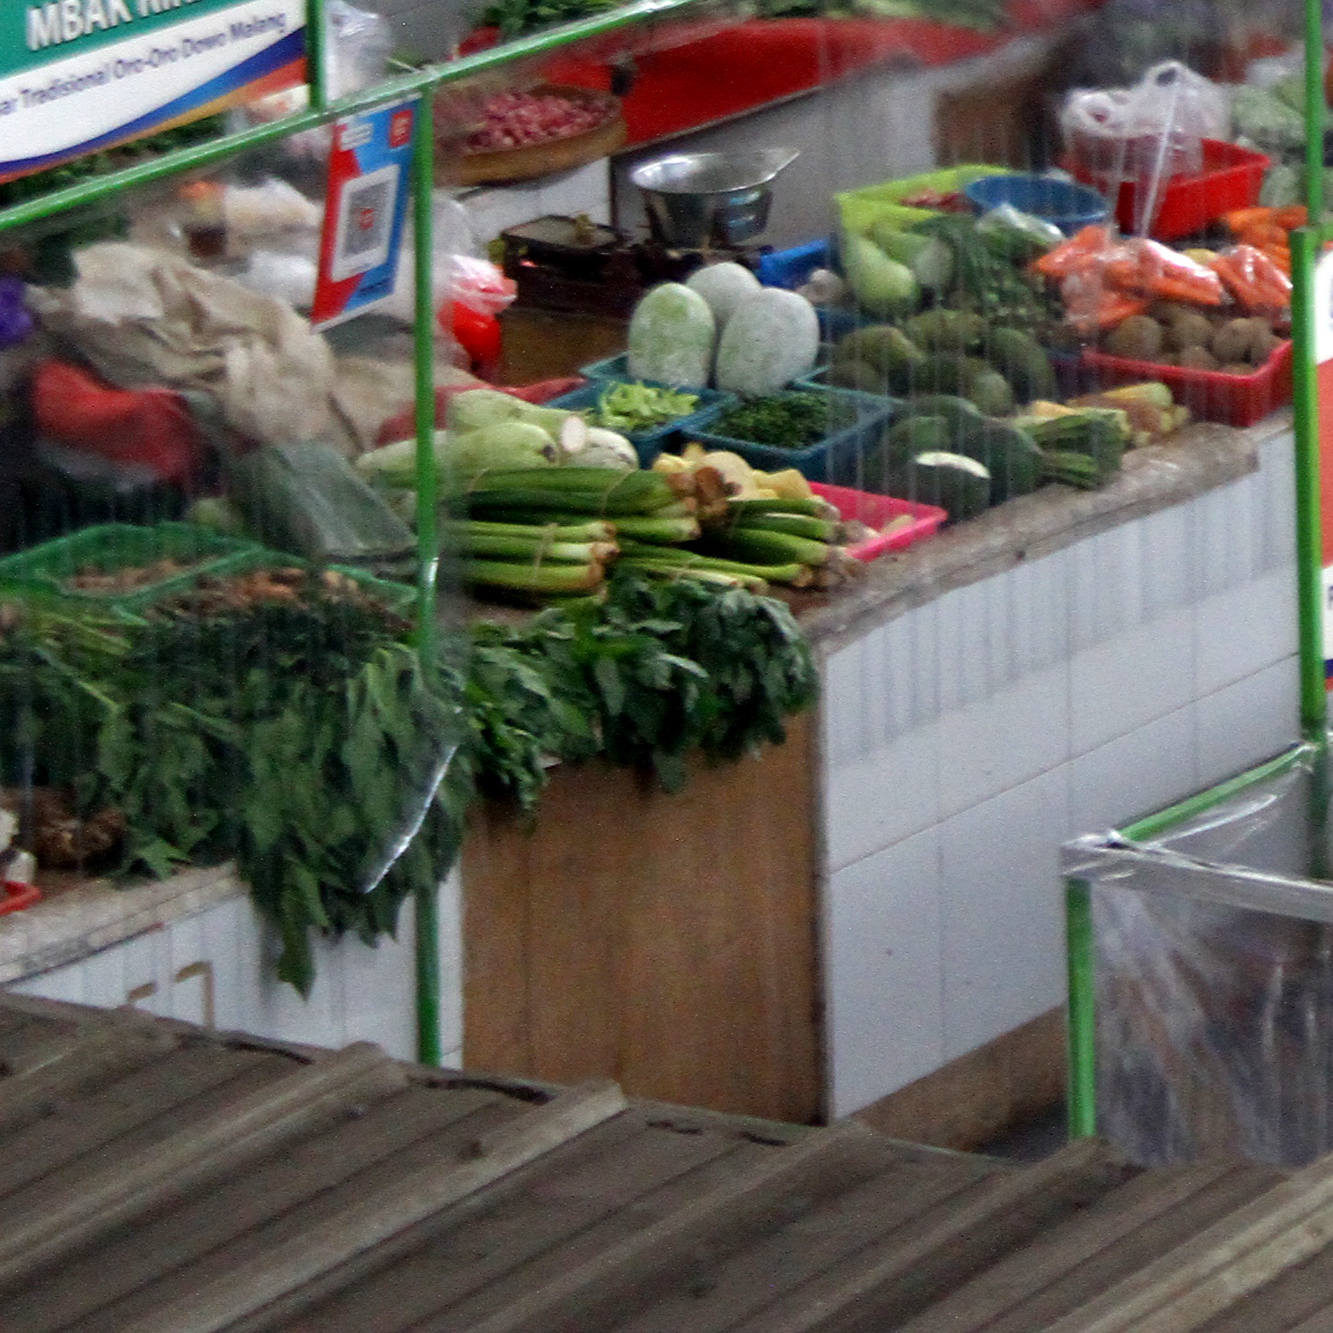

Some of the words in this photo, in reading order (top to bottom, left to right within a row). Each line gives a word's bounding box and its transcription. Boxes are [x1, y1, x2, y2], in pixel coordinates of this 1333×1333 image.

[21, 64, 112, 106] Tradisional
[114, 45, 180, 80] Oro-Oro
[183, 34, 225, 58] Dowo
[229, 12, 286, 43] Malang
